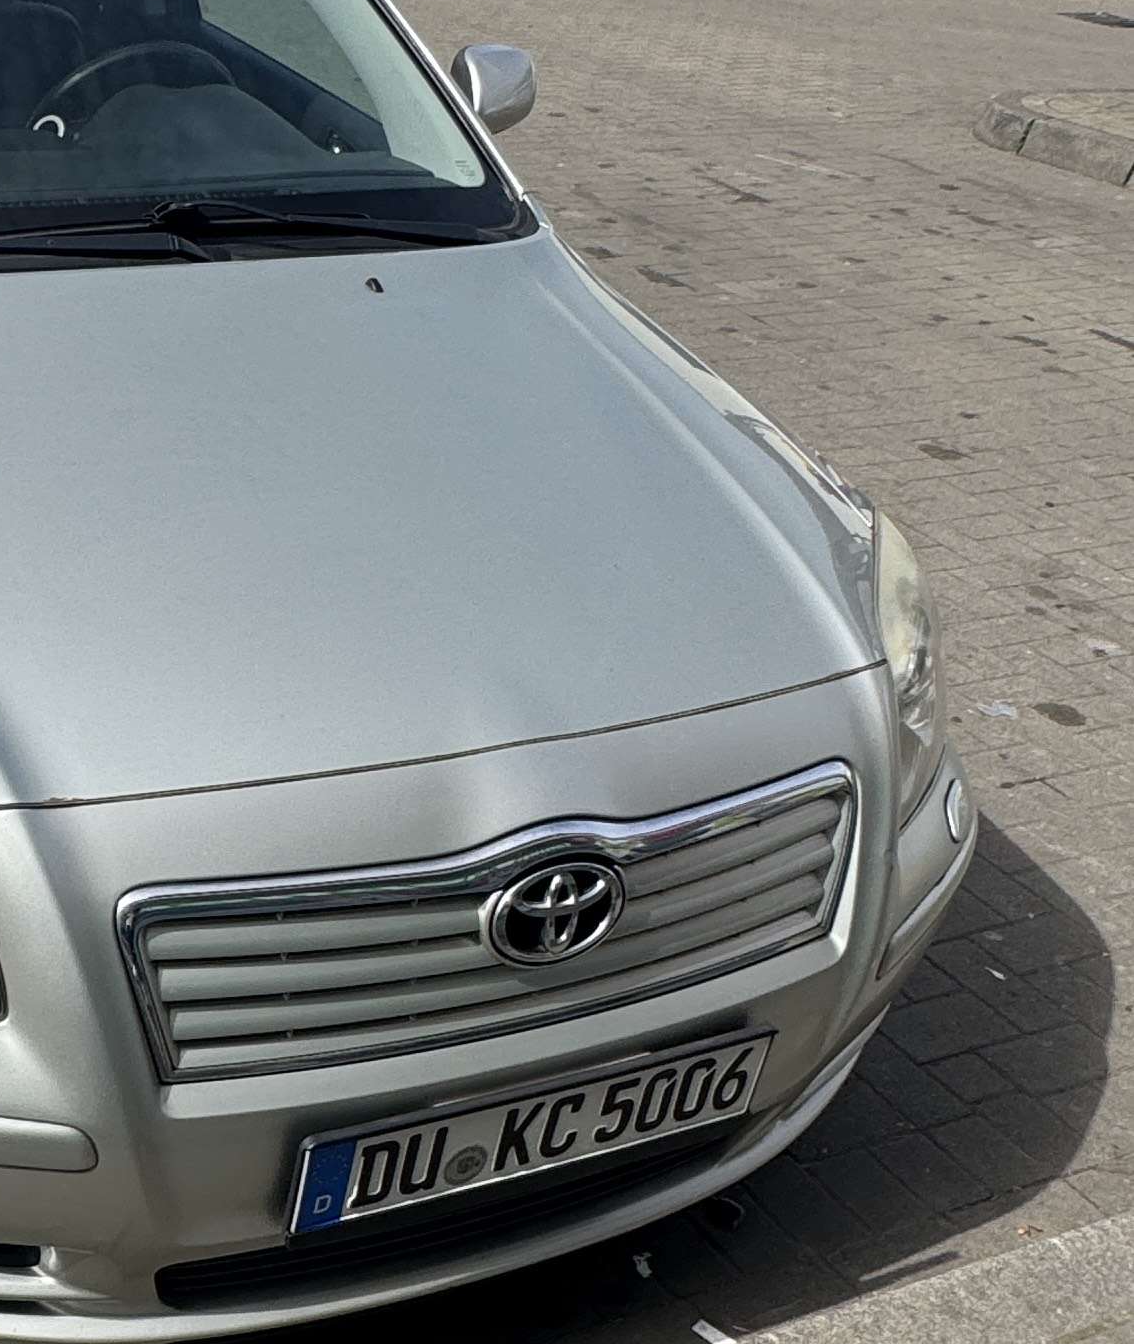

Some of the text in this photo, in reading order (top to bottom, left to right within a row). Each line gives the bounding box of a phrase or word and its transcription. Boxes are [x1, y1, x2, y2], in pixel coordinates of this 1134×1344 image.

[347, 1047, 751, 1210] DU KC 5006
[312, 1193, 333, 1215] D
